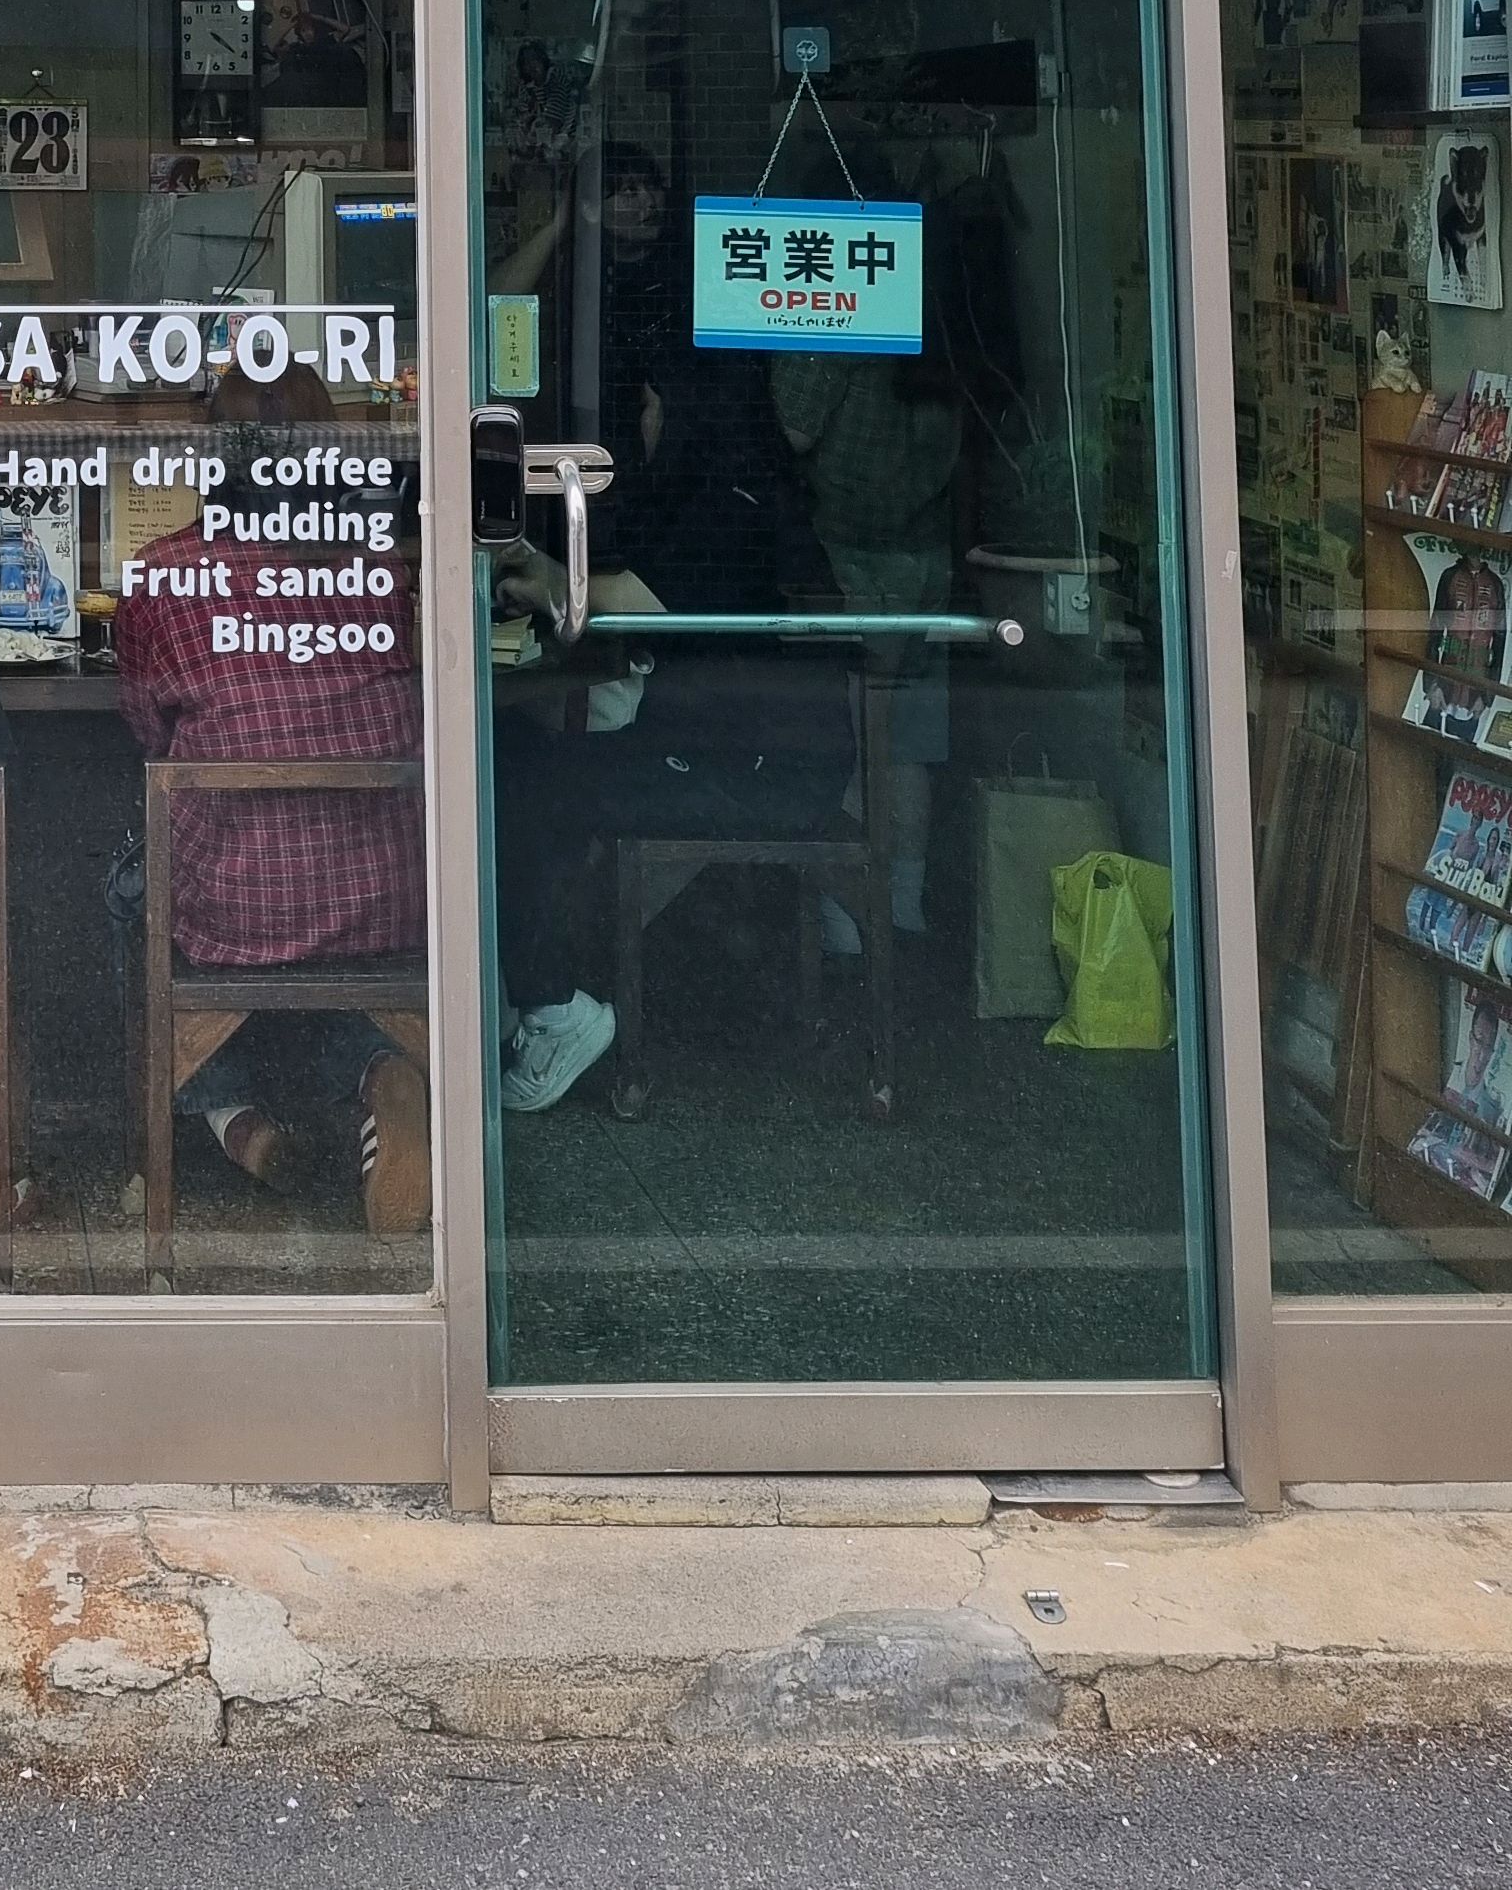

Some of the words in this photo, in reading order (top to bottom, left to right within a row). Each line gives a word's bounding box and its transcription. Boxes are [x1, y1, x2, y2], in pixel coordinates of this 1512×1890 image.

[195, 5, 203, 14] 11
[211, 5, 221, 14] 12
[229, 5, 234, 14] 1
[183, 16, 193, 25] 10
[241, 15, 249, 25] 2
[184, 34, 191, 43] 9
[241, 34, 249, 43] 3
[184, 51, 191, 60] 8
[240, 51, 248, 60] 4
[196, 62, 204, 71] 7
[212, 62, 220, 71] 6
[228, 62, 236, 71] 5
[8, 110, 71, 174] 23
[721, 227, 895, 287] 営業中
[759, 288, 858, 312] OPEN
[98, 315, 395, 385] KO-O-RI
[132, 446, 226, 496] drip
[250, 447, 392, 487] coffee
[203, 501, 395, 551] Pudding
[122, 556, 232, 597] Fruit
[255, 557, 394, 598] sando
[212, 611, 395, 664] Bingsoo
